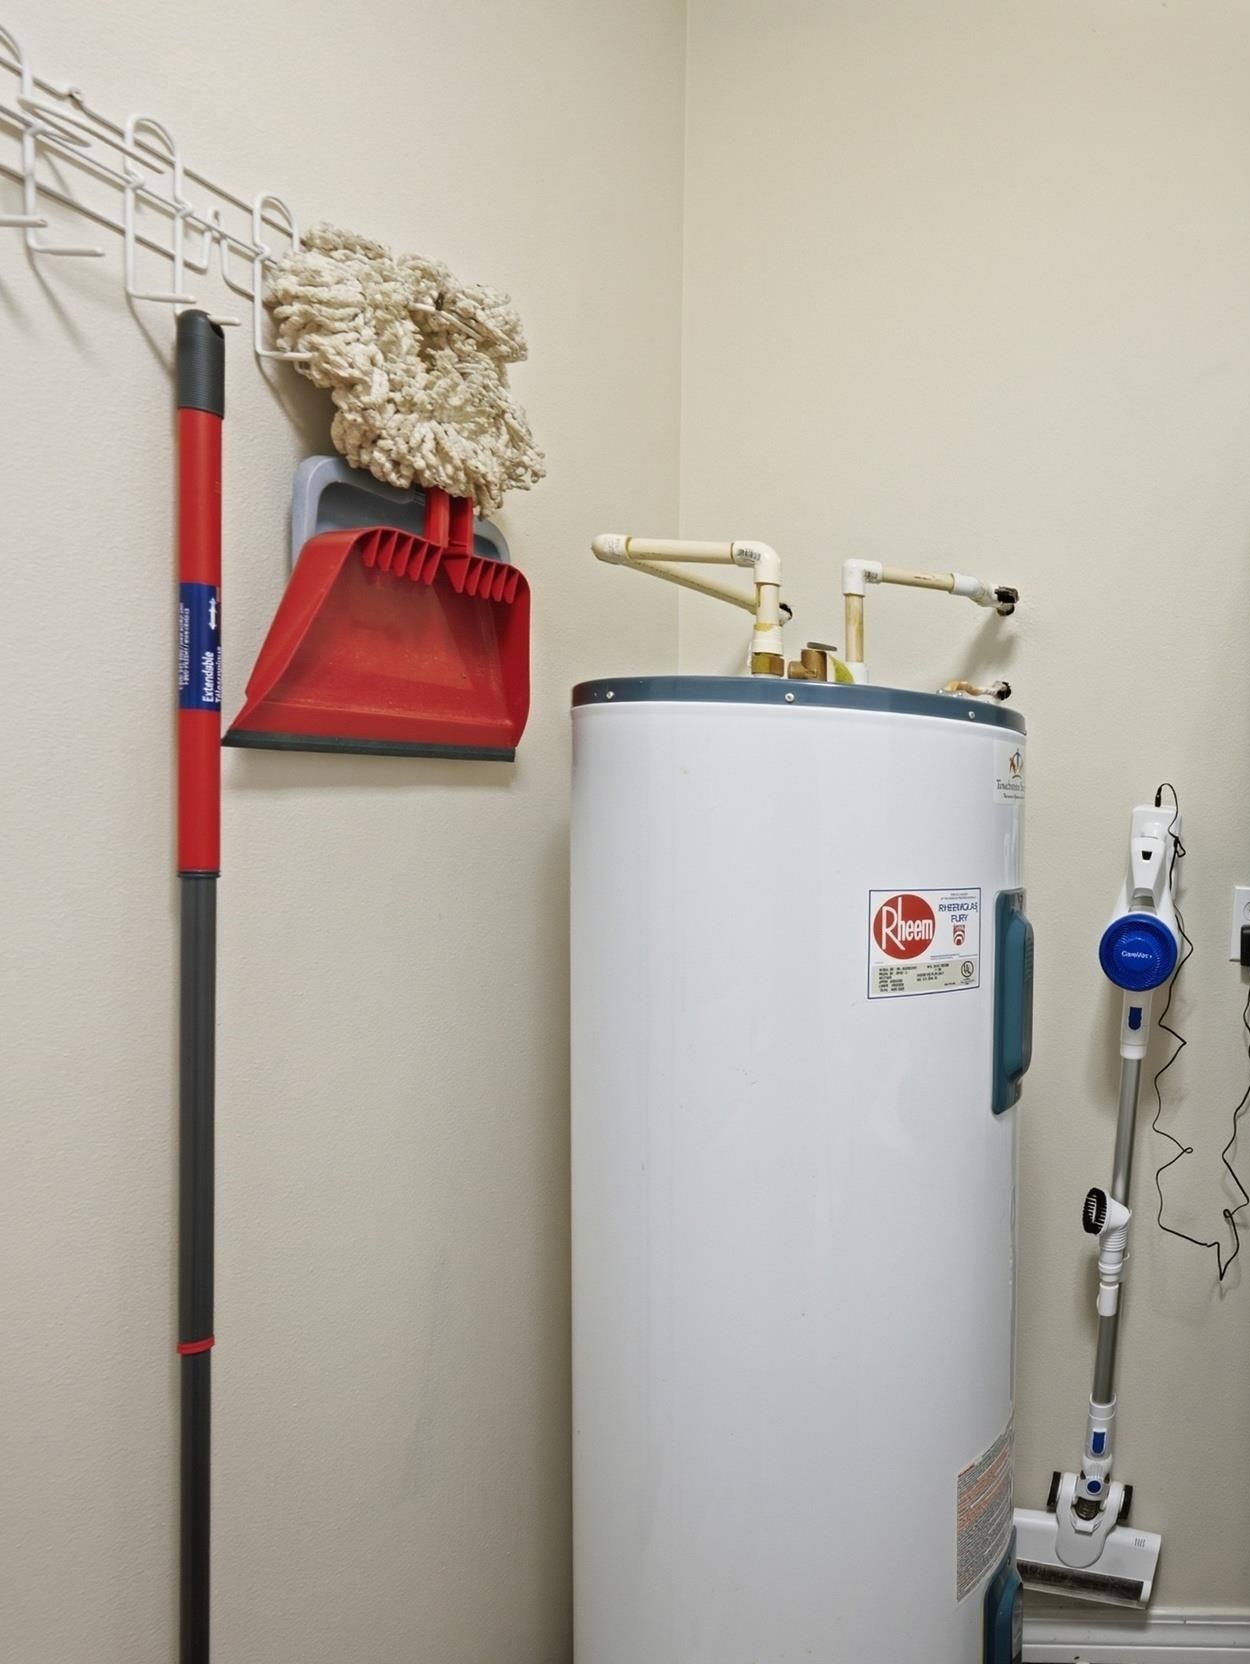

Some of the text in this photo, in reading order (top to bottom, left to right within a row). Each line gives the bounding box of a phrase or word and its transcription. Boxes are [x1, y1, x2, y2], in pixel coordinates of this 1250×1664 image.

[202, 651, 214, 702] Extendable
[881, 896, 933, 950] Rheem
[951, 914, 968, 922] FURY
